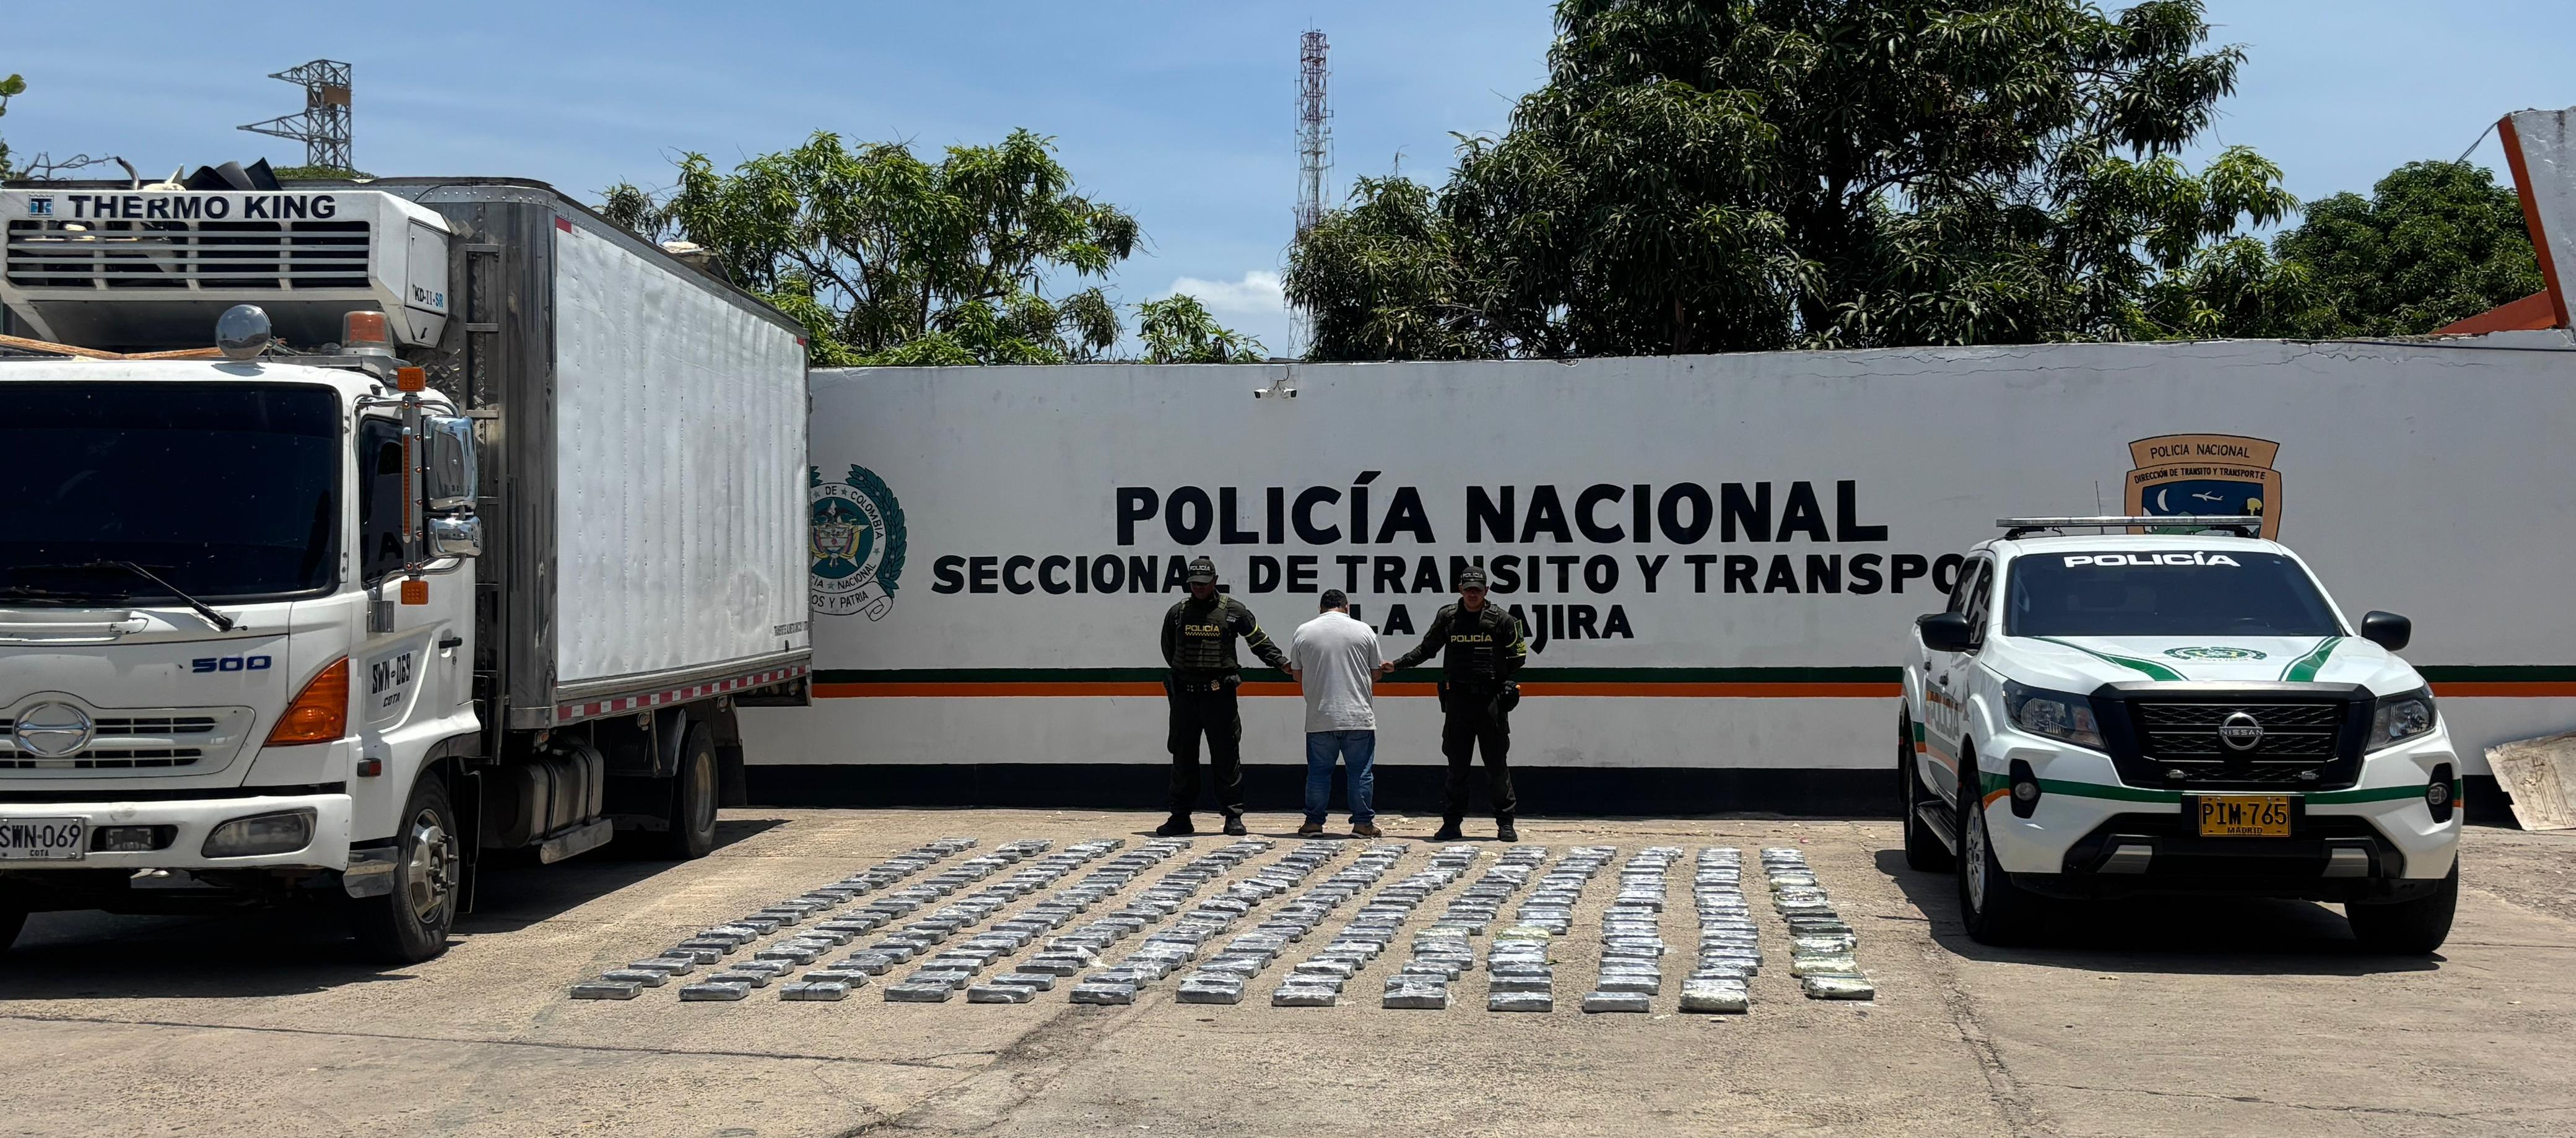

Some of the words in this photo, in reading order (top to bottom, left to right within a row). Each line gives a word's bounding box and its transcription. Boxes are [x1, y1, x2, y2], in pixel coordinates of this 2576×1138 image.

[68, 196, 230, 219] THERMO
[245, 196, 336, 219] KING
[2150, 444, 2190, 459] POLICIA
[2196, 444, 2250, 458] NACIONAL
[2134, 468, 2167, 484] DIRECCIÓN
[2170, 468, 2178, 476] DE
[2181, 467, 2211, 476] TRANSITO
[2219, 468, 2266, 479] TRANSPORTE
[825, 486, 837, 495] DE
[851, 491, 884, 540] COLOMBIA
[1116, 471, 1436, 545] POLICÍA
[1466, 480, 1888, 545] NACIONAL
[2063, 551, 2241, 568] POLICÍA
[838, 563, 876, 590] NACIONAL
[931, 554, 1230, 594] SECCIONA
[1249, 555, 1318, 593] DE
[1635, 554, 1670, 593] Y
[829, 597, 835, 608] Y
[840, 590, 869, 608] PATRIA
[1185, 624, 1221, 632] POLICÍA
[1451, 632, 1493, 643] POLICÍA
[192, 655, 272, 673] 500
[383, 692, 401, 707] COTA
